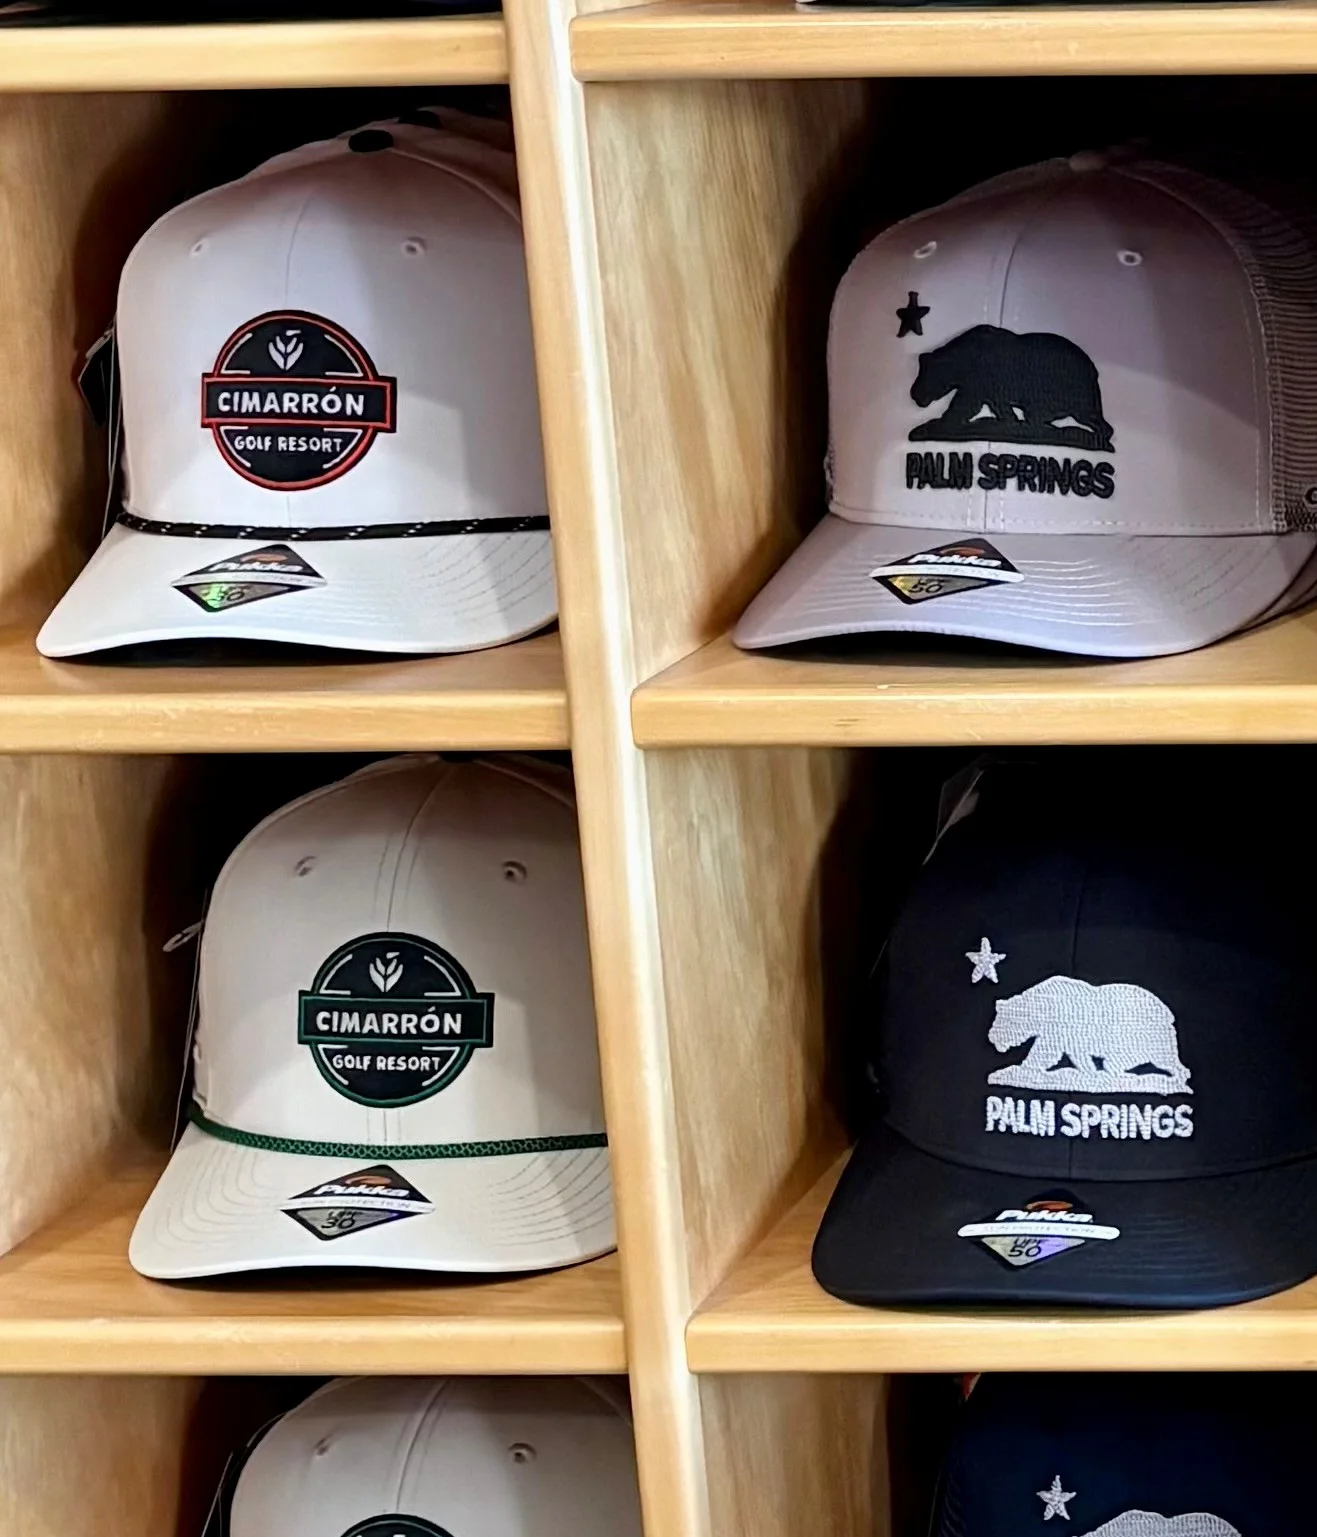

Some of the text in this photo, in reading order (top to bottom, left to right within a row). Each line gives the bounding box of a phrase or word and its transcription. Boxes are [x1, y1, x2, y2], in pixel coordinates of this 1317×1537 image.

[217, 388, 365, 418] CIMARRÓN
[234, 434, 342, 454] GOLF RESORT
[905, 449, 1115, 501] PALM SPRINGS
[315, 1007, 462, 1034] CIMARRÓN
[331, 1052, 442, 1073] GOLF RESORT
[985, 1095, 1194, 1140] PALM SPRINGS
[995, 1210, 1094, 1223] Pukka
[1009, 1244, 1043, 1258] 50
